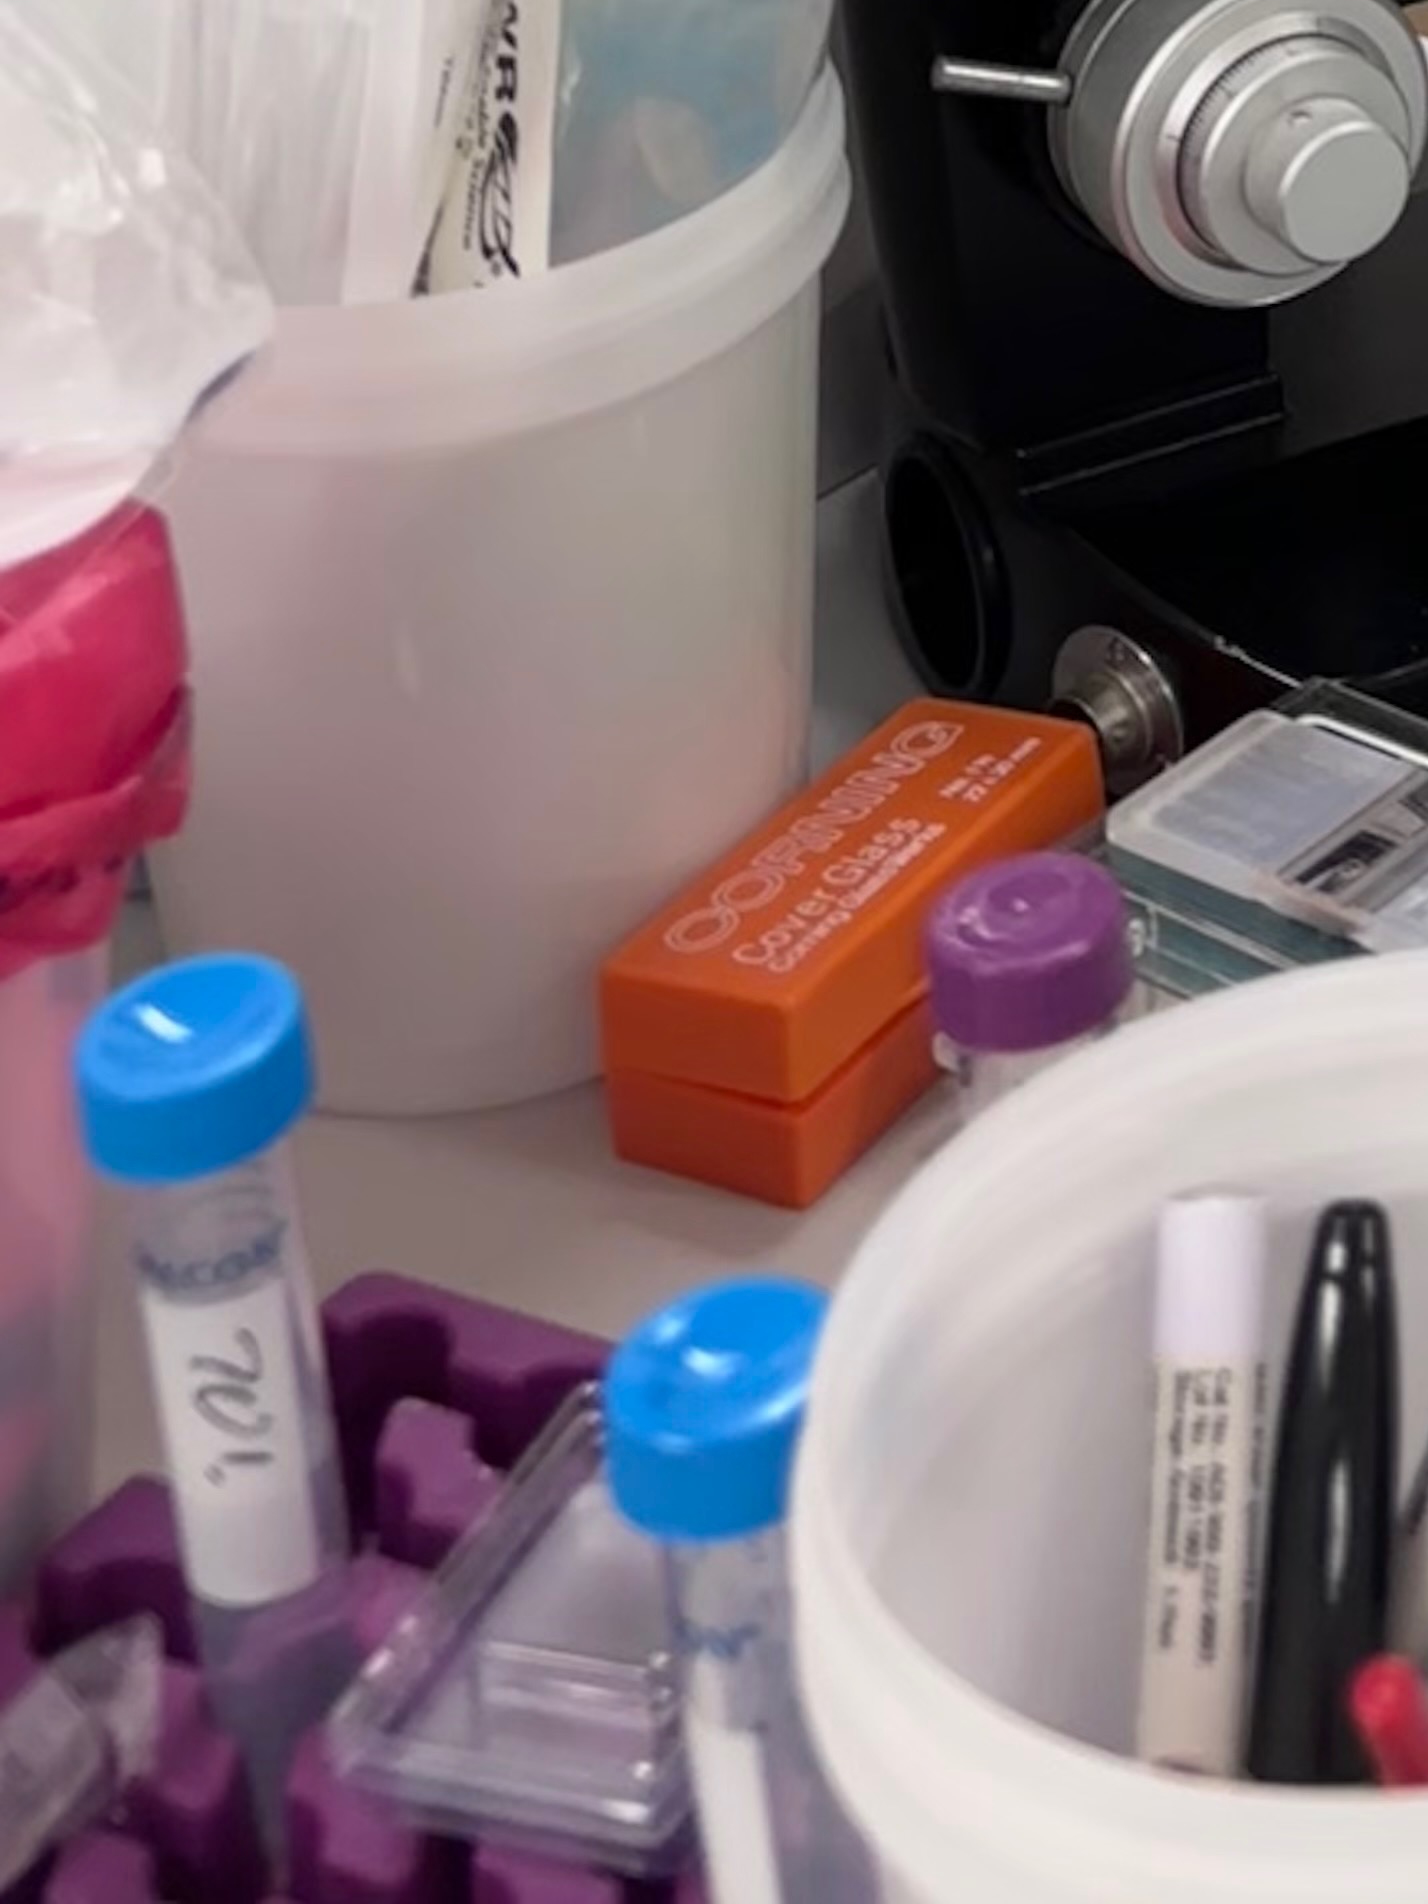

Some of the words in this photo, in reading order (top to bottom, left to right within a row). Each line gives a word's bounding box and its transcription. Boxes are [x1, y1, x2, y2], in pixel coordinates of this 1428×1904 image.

[664, 719, 965, 954] CORNING
[731, 882, 829, 967] Cover
[822, 817, 923, 889] Glass
